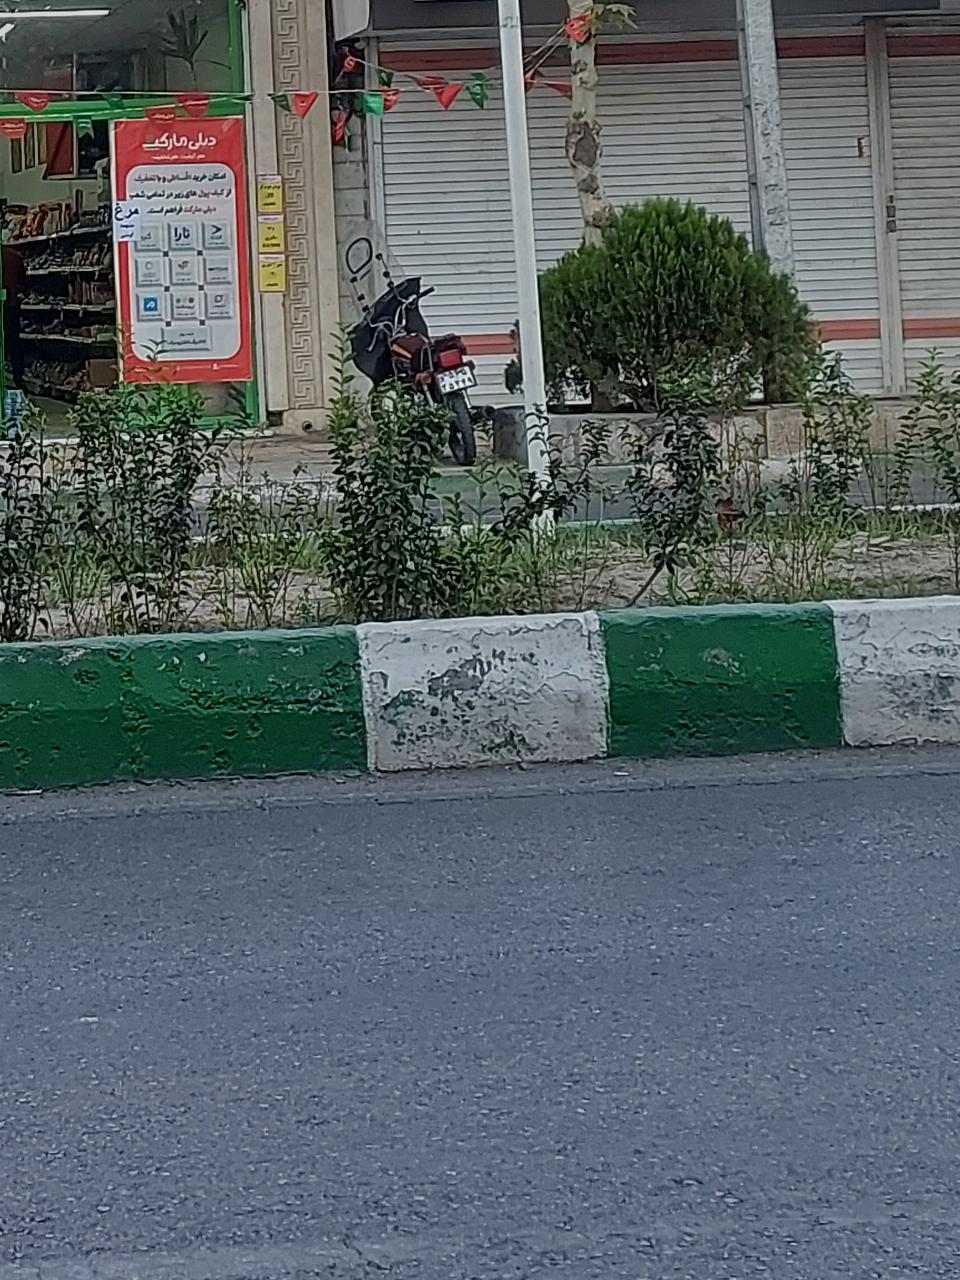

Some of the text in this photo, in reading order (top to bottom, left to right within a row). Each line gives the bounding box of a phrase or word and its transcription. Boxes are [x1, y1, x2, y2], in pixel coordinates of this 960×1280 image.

[142, 133, 188, 151] مارکت
[192, 173, 207, 183] خرید
[208, 173, 227, 182] امکان
[114, 202, 140, 221] مرغ
[174, 227, 190, 242] تارا
